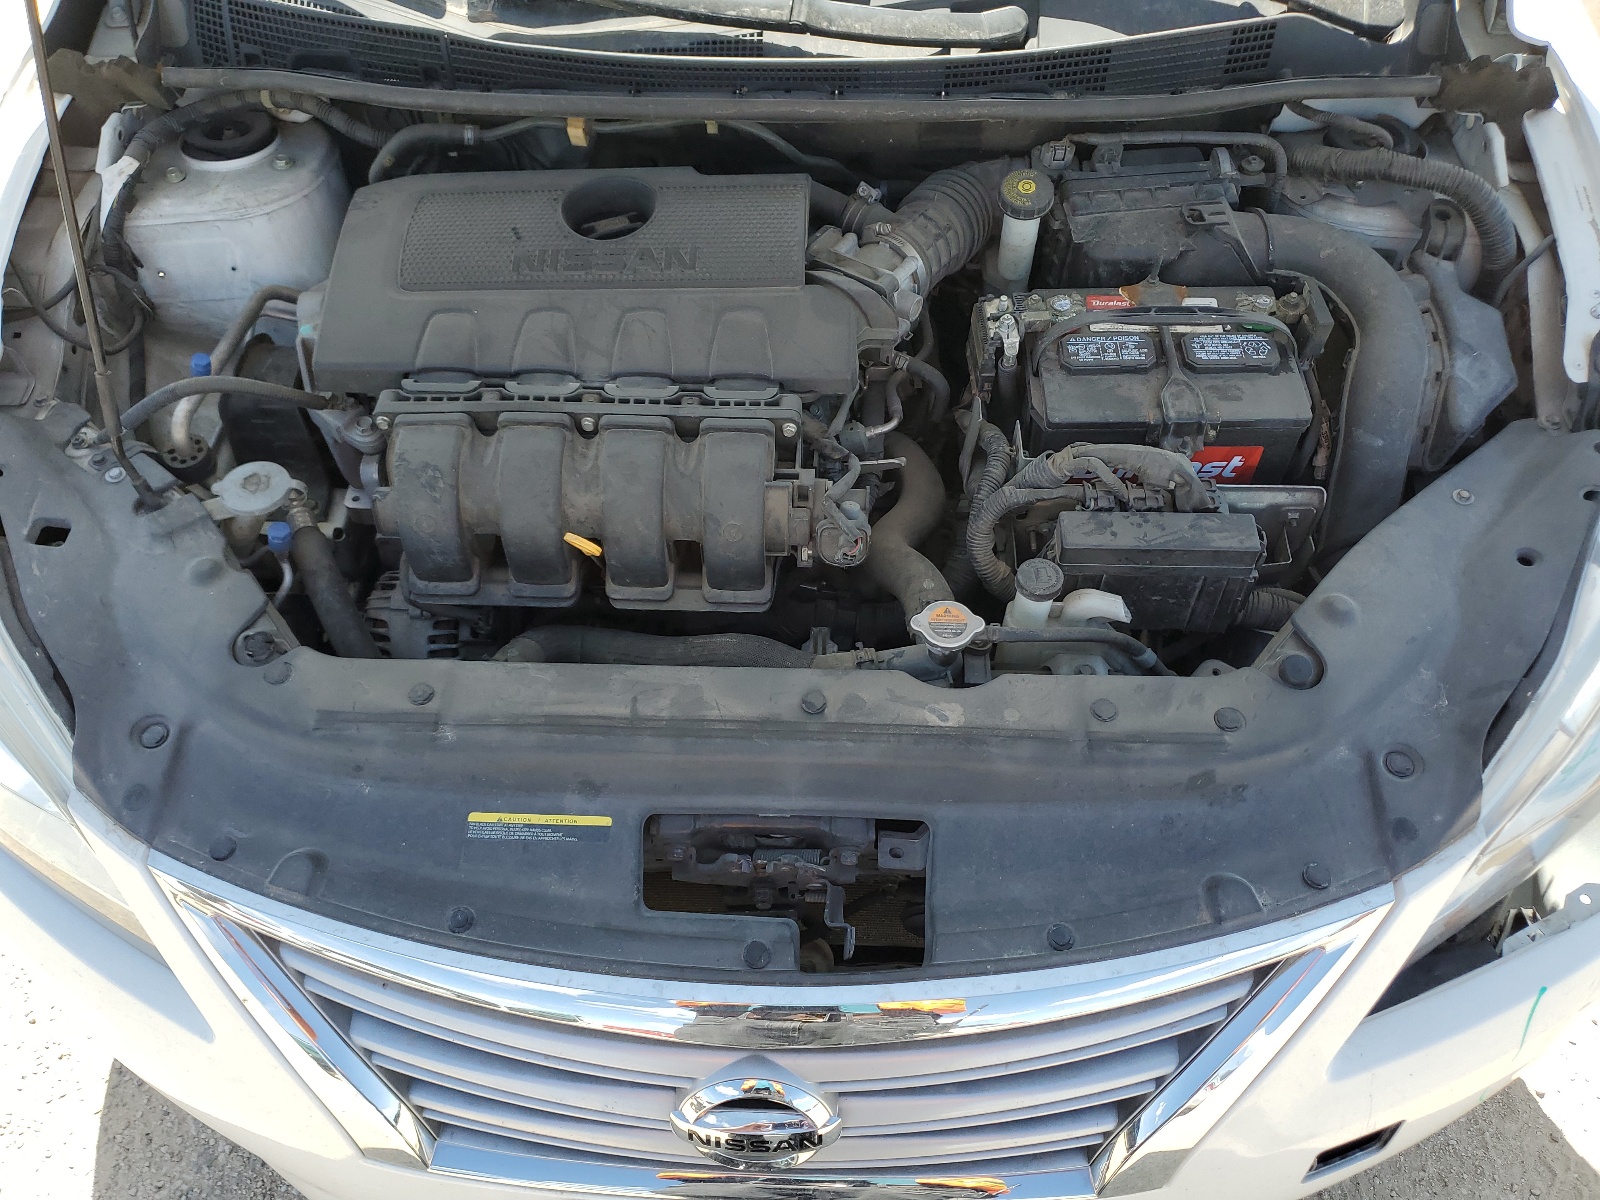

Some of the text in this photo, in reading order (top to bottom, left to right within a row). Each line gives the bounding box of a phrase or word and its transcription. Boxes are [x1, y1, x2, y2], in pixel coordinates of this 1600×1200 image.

[511, 246, 699, 274] NISSAN
[1091, 299, 1131, 307] Duralast
[687, 1128, 823, 1153] NISSAN
